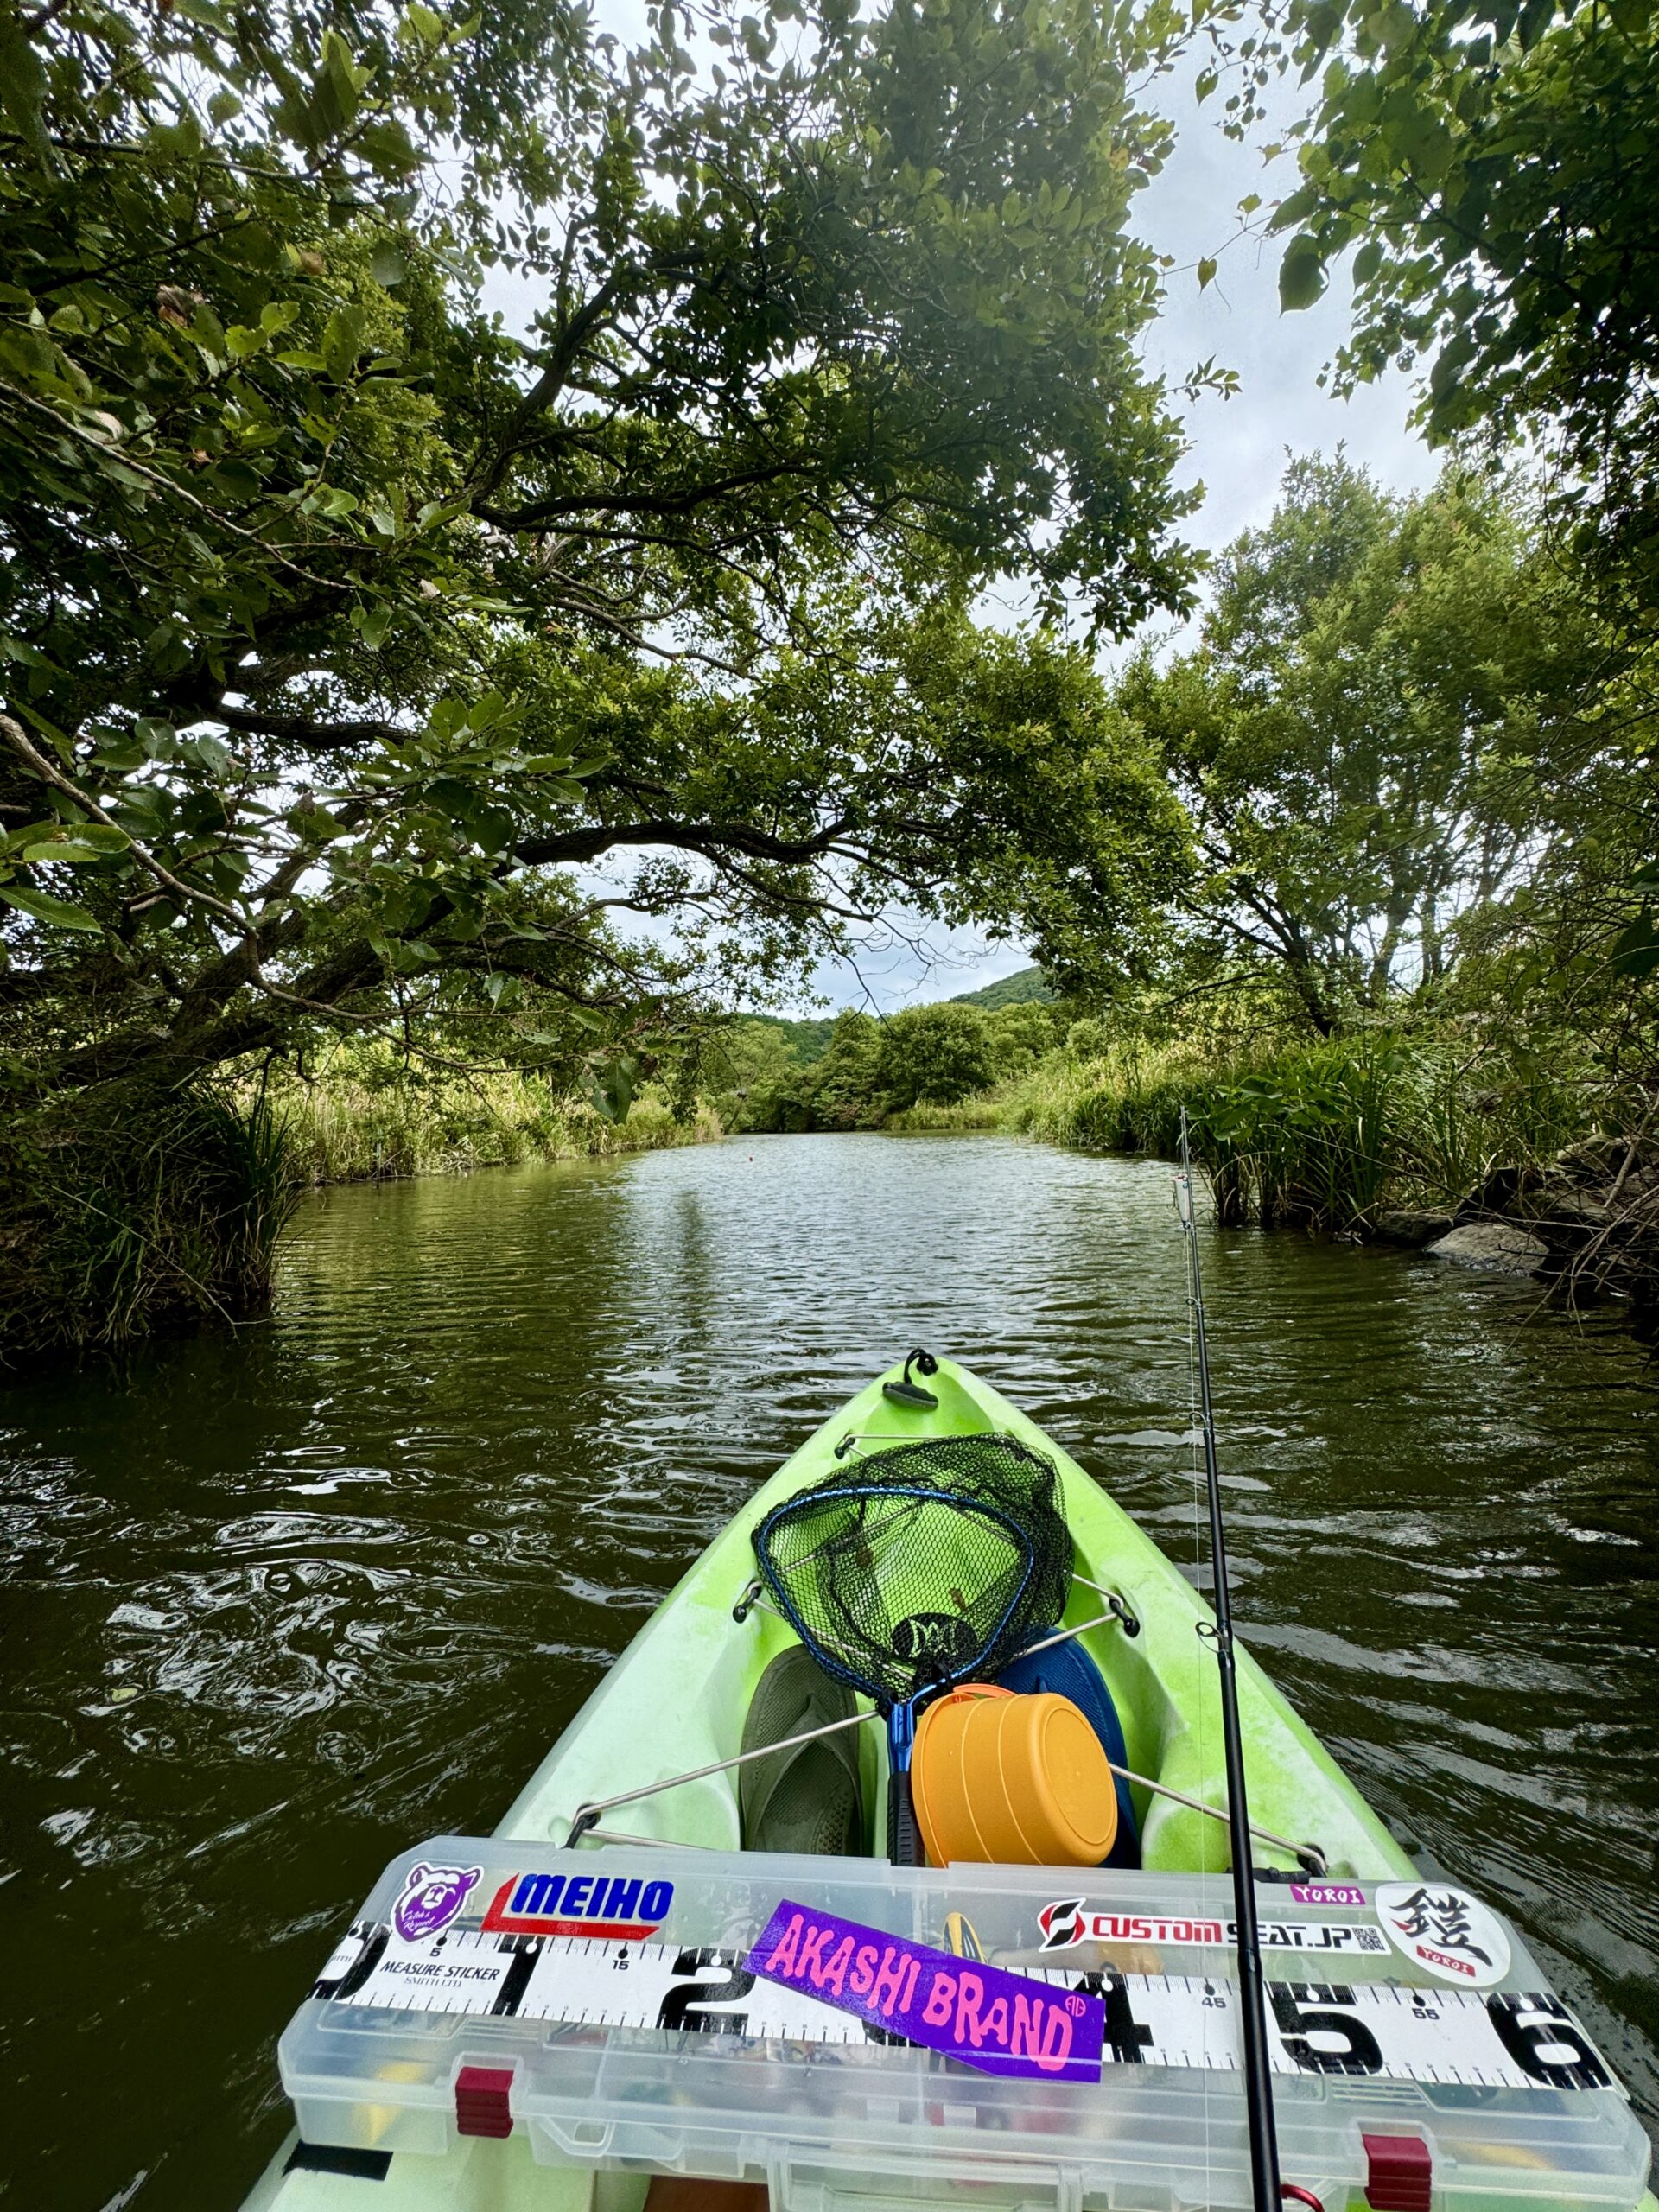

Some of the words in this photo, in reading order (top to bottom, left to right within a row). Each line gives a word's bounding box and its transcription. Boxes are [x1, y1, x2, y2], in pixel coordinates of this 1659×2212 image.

[511, 1873, 674, 1921] MEIHO
[1294, 1886, 1361, 1904] YOROI
[1389, 1888, 1493, 1967] 鎧
[429, 1948, 442, 1957] 5
[612, 1959, 630, 1970] 15
[1421, 1947, 1470, 1974] YOROI
[380, 1961, 445, 1977] MEASURE
[443, 1966, 501, 1980] STICKER
[656, 1947, 757, 2037] 2
[765, 1914, 921, 2016] AKASHI
[923, 1971, 1073, 2072] BRAND
[1201, 1996, 1226, 2009] 45
[1264, 1980, 1383, 2074] 5
[1412, 2007, 1440, 2020] 55
[1486, 1991, 1614, 2090] 6
